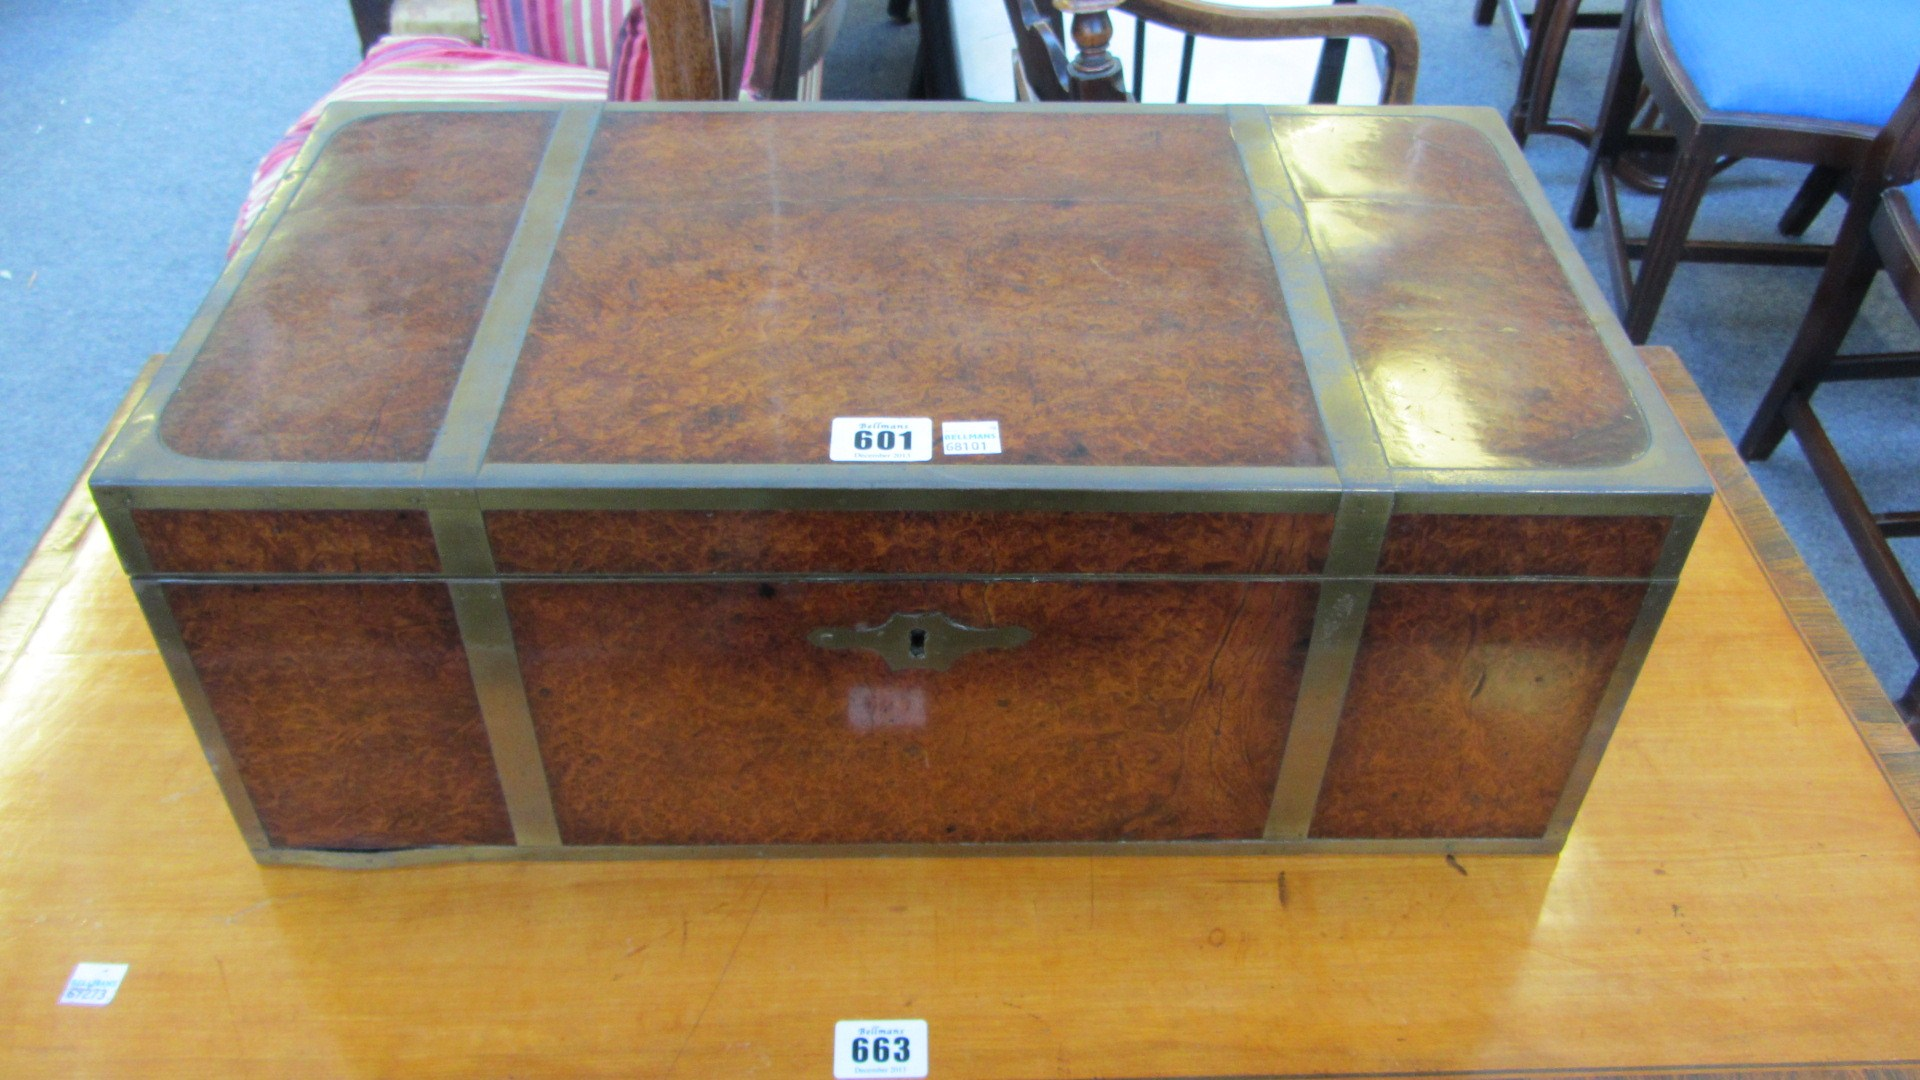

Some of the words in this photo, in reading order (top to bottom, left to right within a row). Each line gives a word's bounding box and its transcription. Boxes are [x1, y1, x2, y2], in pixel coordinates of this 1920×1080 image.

[854, 430, 912, 450] 601
[858, 1026, 904, 1035] Bellmans
[852, 1036, 910, 1063] 663
